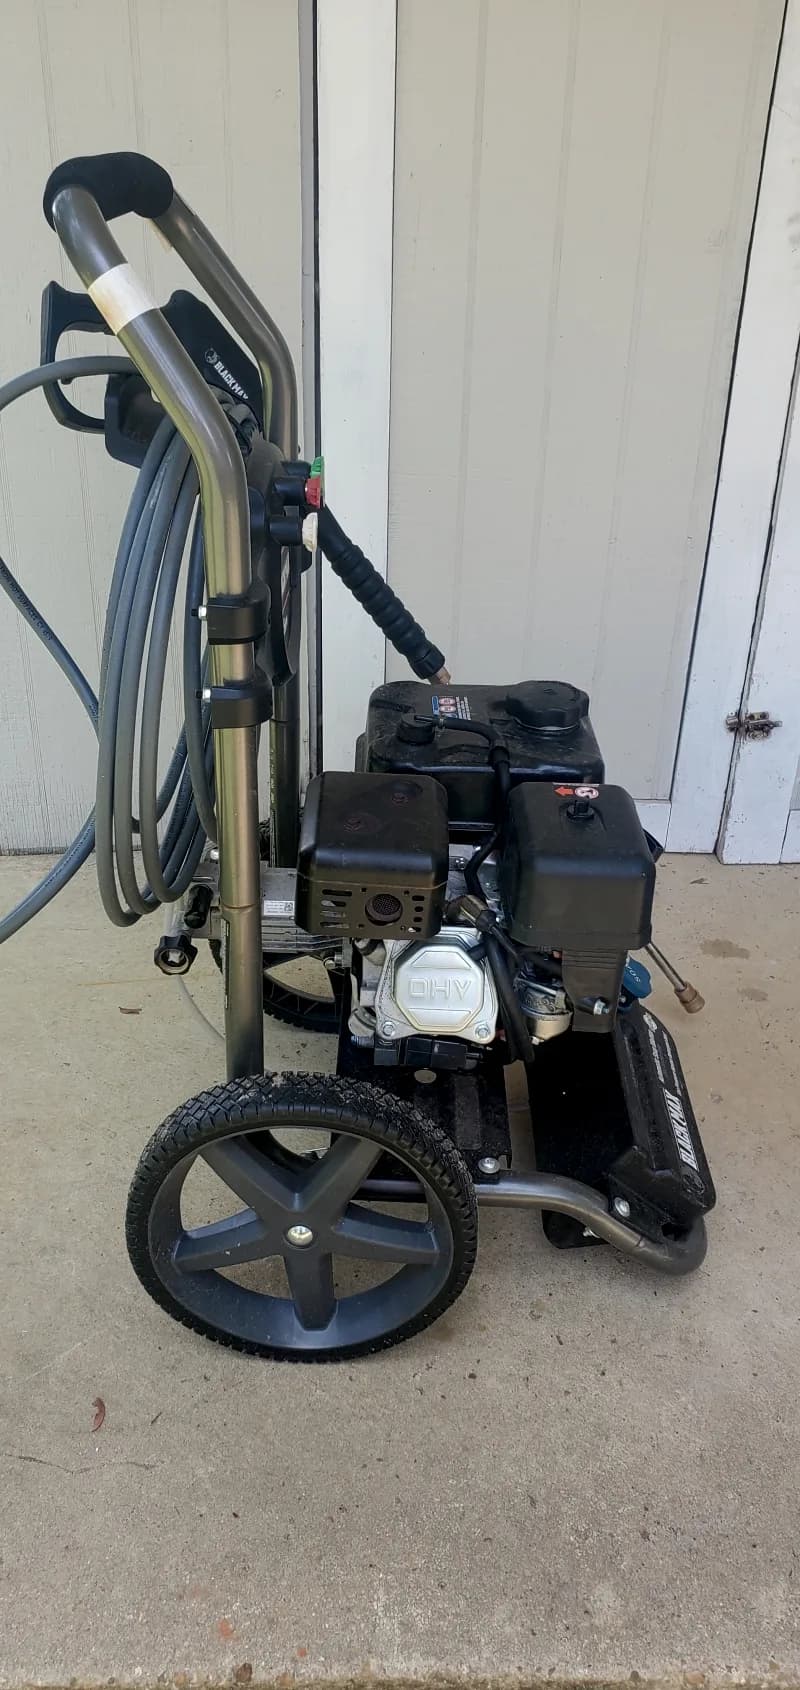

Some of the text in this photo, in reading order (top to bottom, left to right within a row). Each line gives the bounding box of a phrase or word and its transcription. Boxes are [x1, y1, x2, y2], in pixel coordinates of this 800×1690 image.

[214, 361, 235, 387] BLACK
[408, 976, 472, 1001] OHV
[663, 1088, 688, 1127] MAX
[673, 1118, 698, 1171] BLACK
